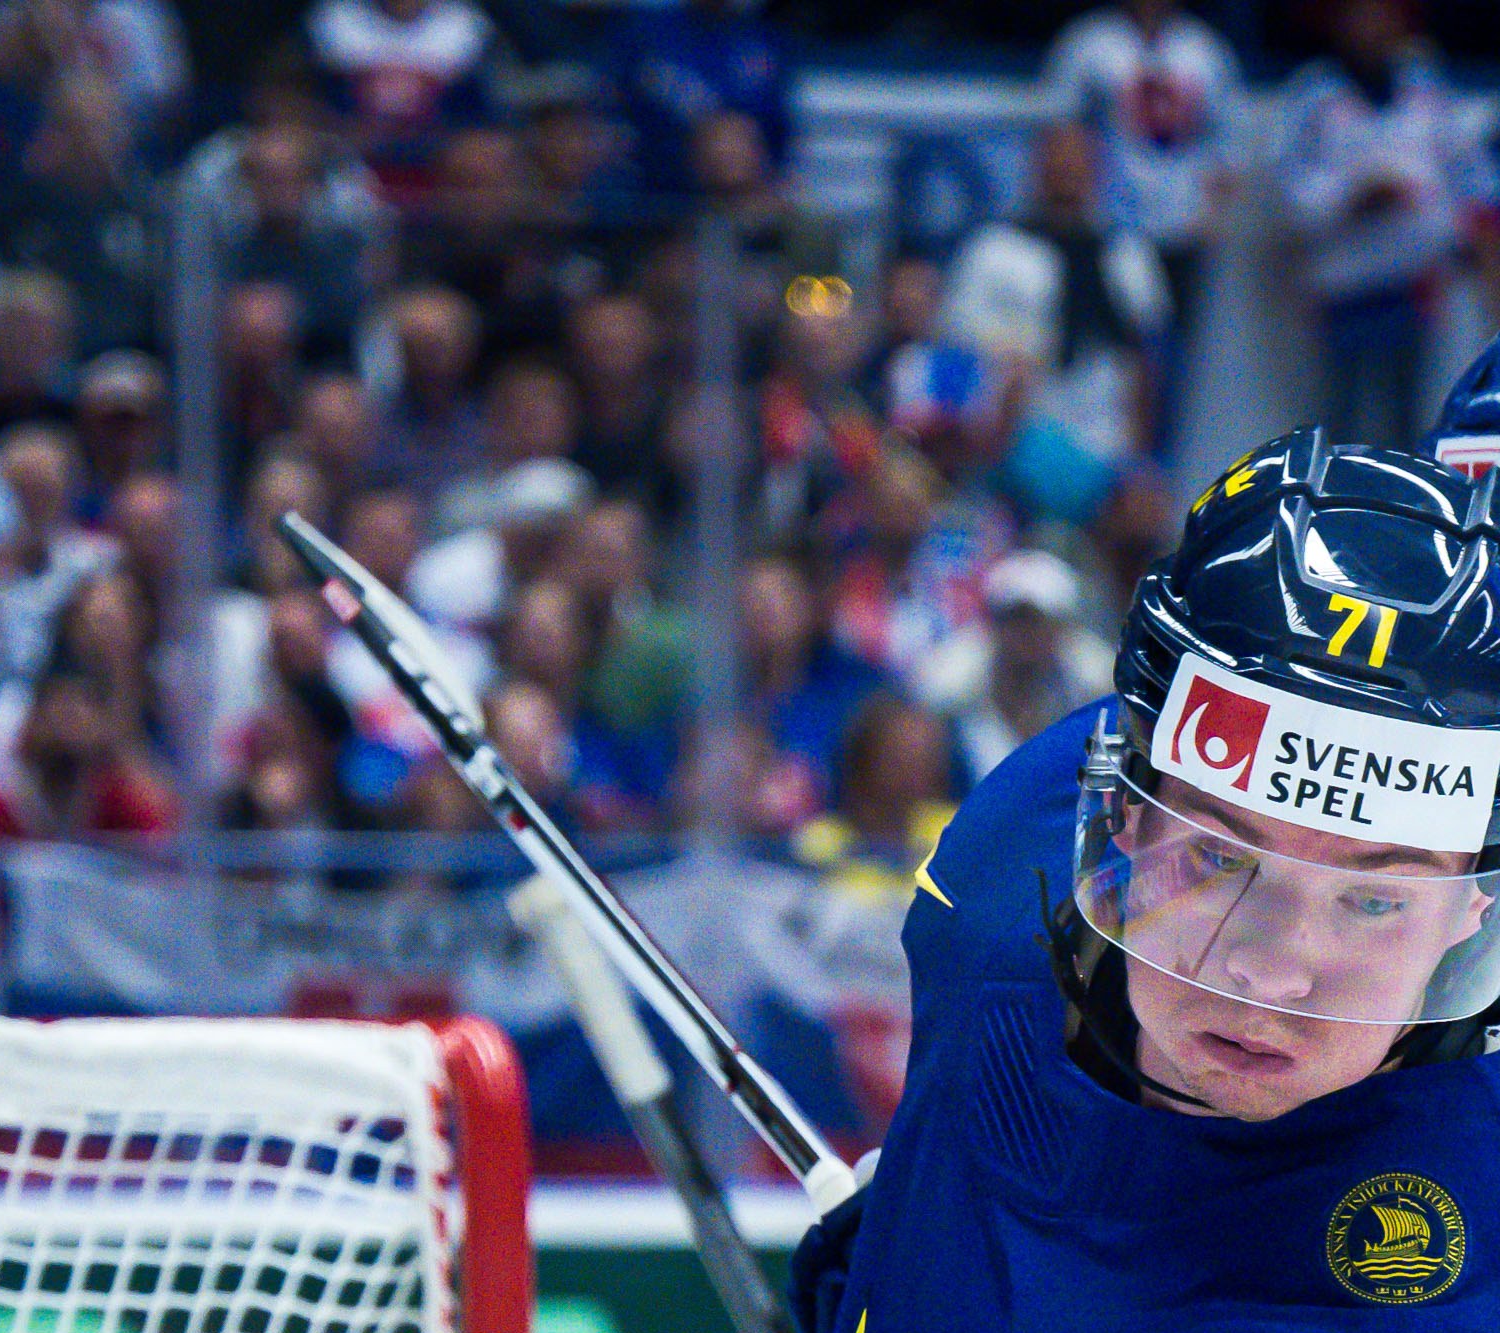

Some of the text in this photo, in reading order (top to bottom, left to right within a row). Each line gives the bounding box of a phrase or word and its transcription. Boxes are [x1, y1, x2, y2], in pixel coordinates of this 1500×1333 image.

[1326, 592, 1399, 669] 71
[1266, 770, 1373, 826] SPEL
[1275, 731, 1475, 798] SVENSKA
